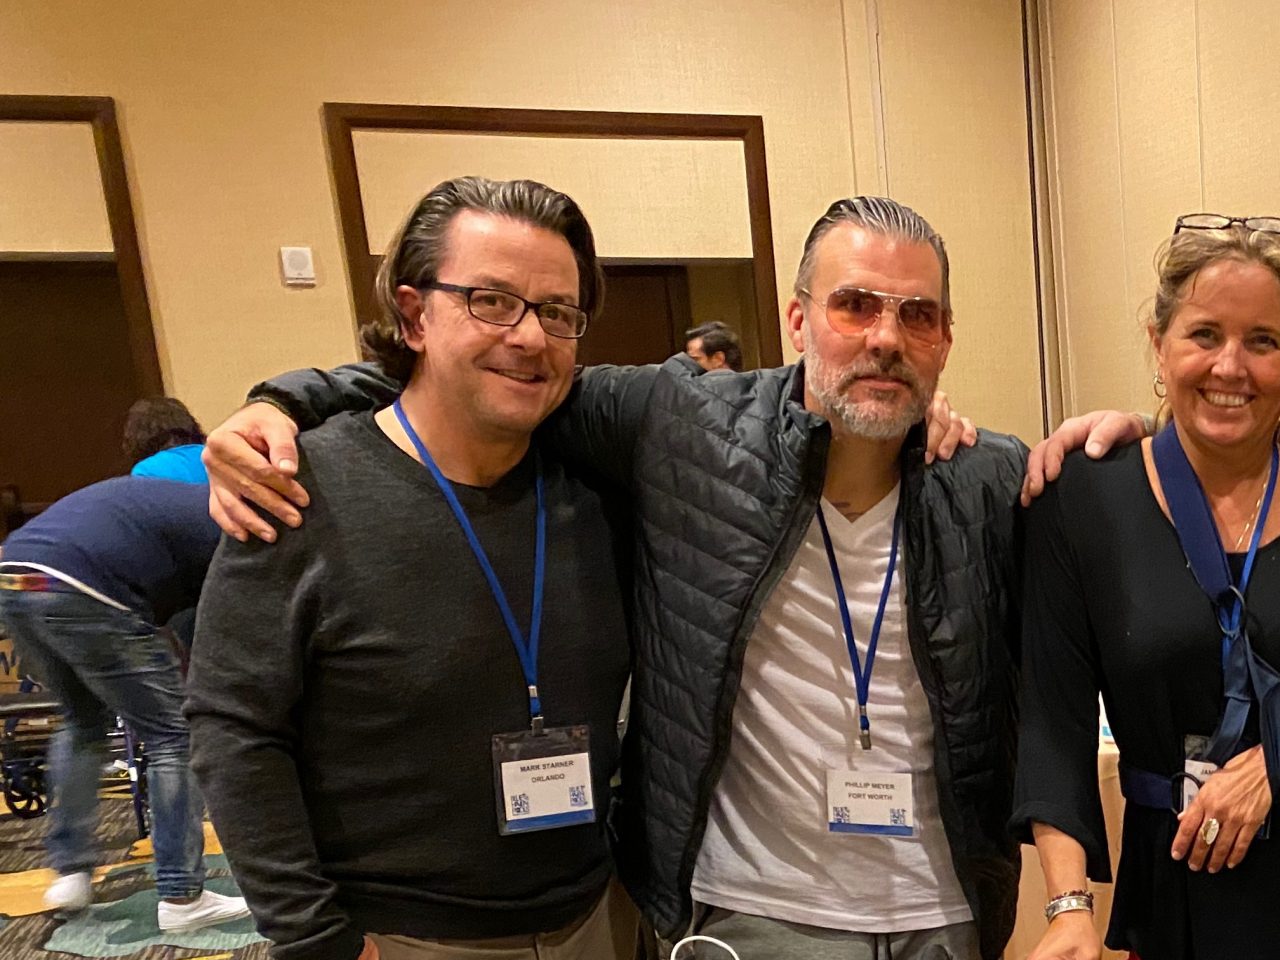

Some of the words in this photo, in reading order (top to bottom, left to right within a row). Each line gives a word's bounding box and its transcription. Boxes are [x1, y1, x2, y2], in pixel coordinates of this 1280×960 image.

[520, 764, 540, 773] MARK
[531, 773, 565, 783] ORLANDO
[844, 781, 870, 789] PHILLIP
[848, 792, 866, 800] FORT
[867, 793, 893, 801] WORTH
